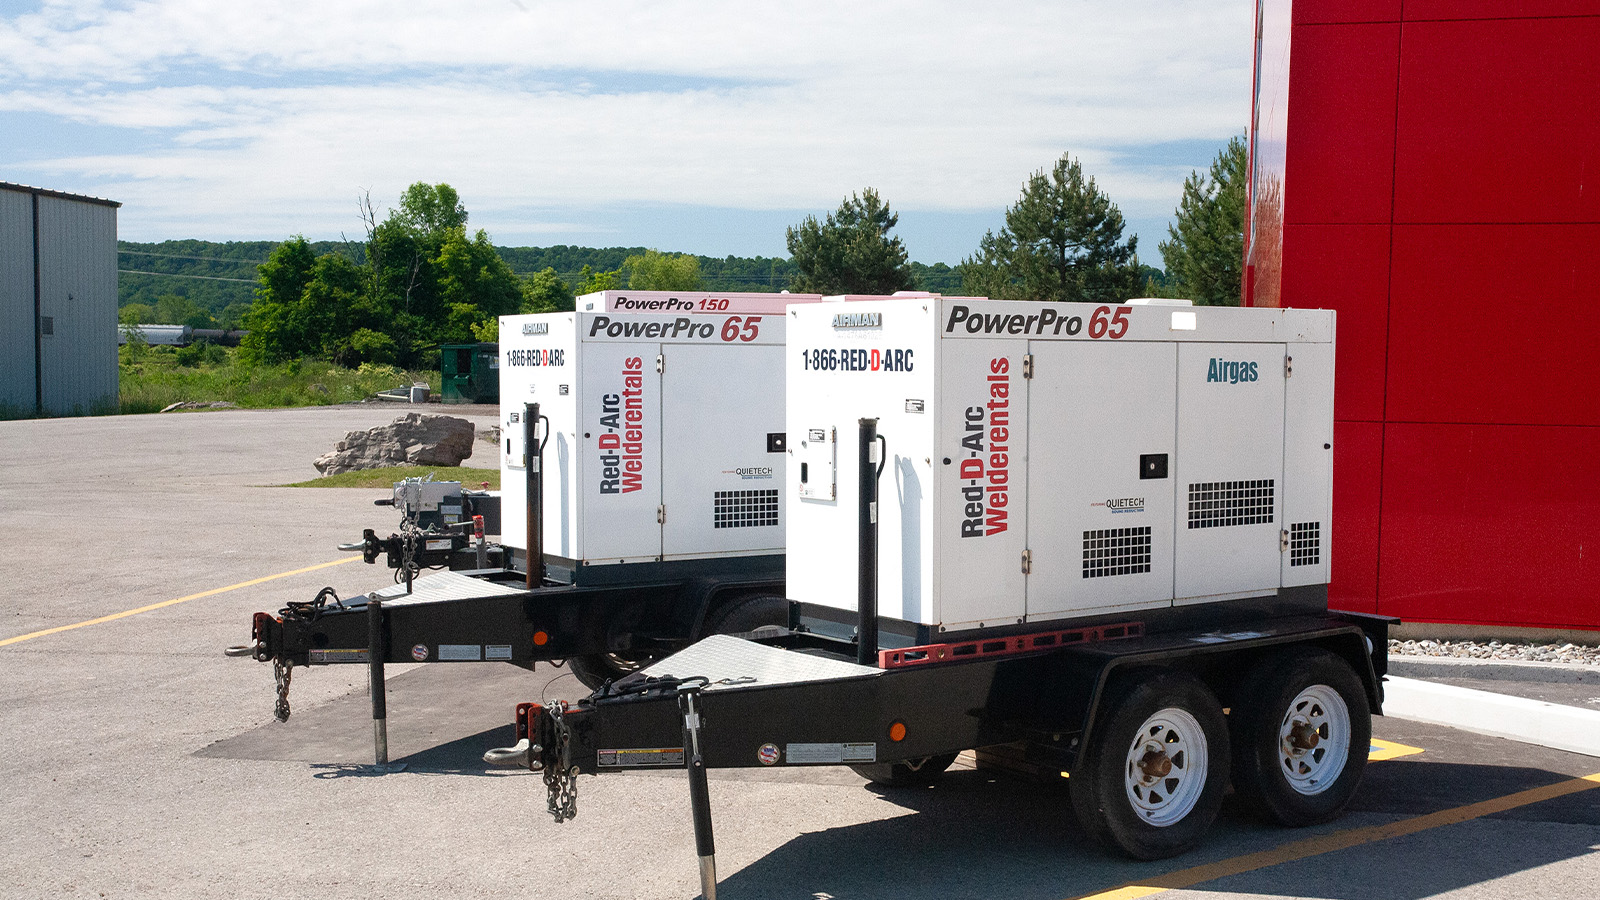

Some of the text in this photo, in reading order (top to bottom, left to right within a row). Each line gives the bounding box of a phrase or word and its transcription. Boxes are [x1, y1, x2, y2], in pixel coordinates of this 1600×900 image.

[614, 297, 730, 311] PowerPro 150
[522, 323, 548, 334] AIRMAN
[589, 315, 762, 342] PowerPro 65
[831, 312, 882, 328] AIRMAN
[946, 305, 1132, 339] PowerPro 65
[1207, 358, 1259, 385] Airgas
[622, 356, 643, 493] Welderentals
[599, 393, 620, 494] Red-D-Arc
[986, 357, 1009, 536] Welderentals
[736, 467, 772, 476] QUIETECH
[960, 406, 985, 538] Red-D-Arc
[1106, 497, 1145, 508] QUIETECH
